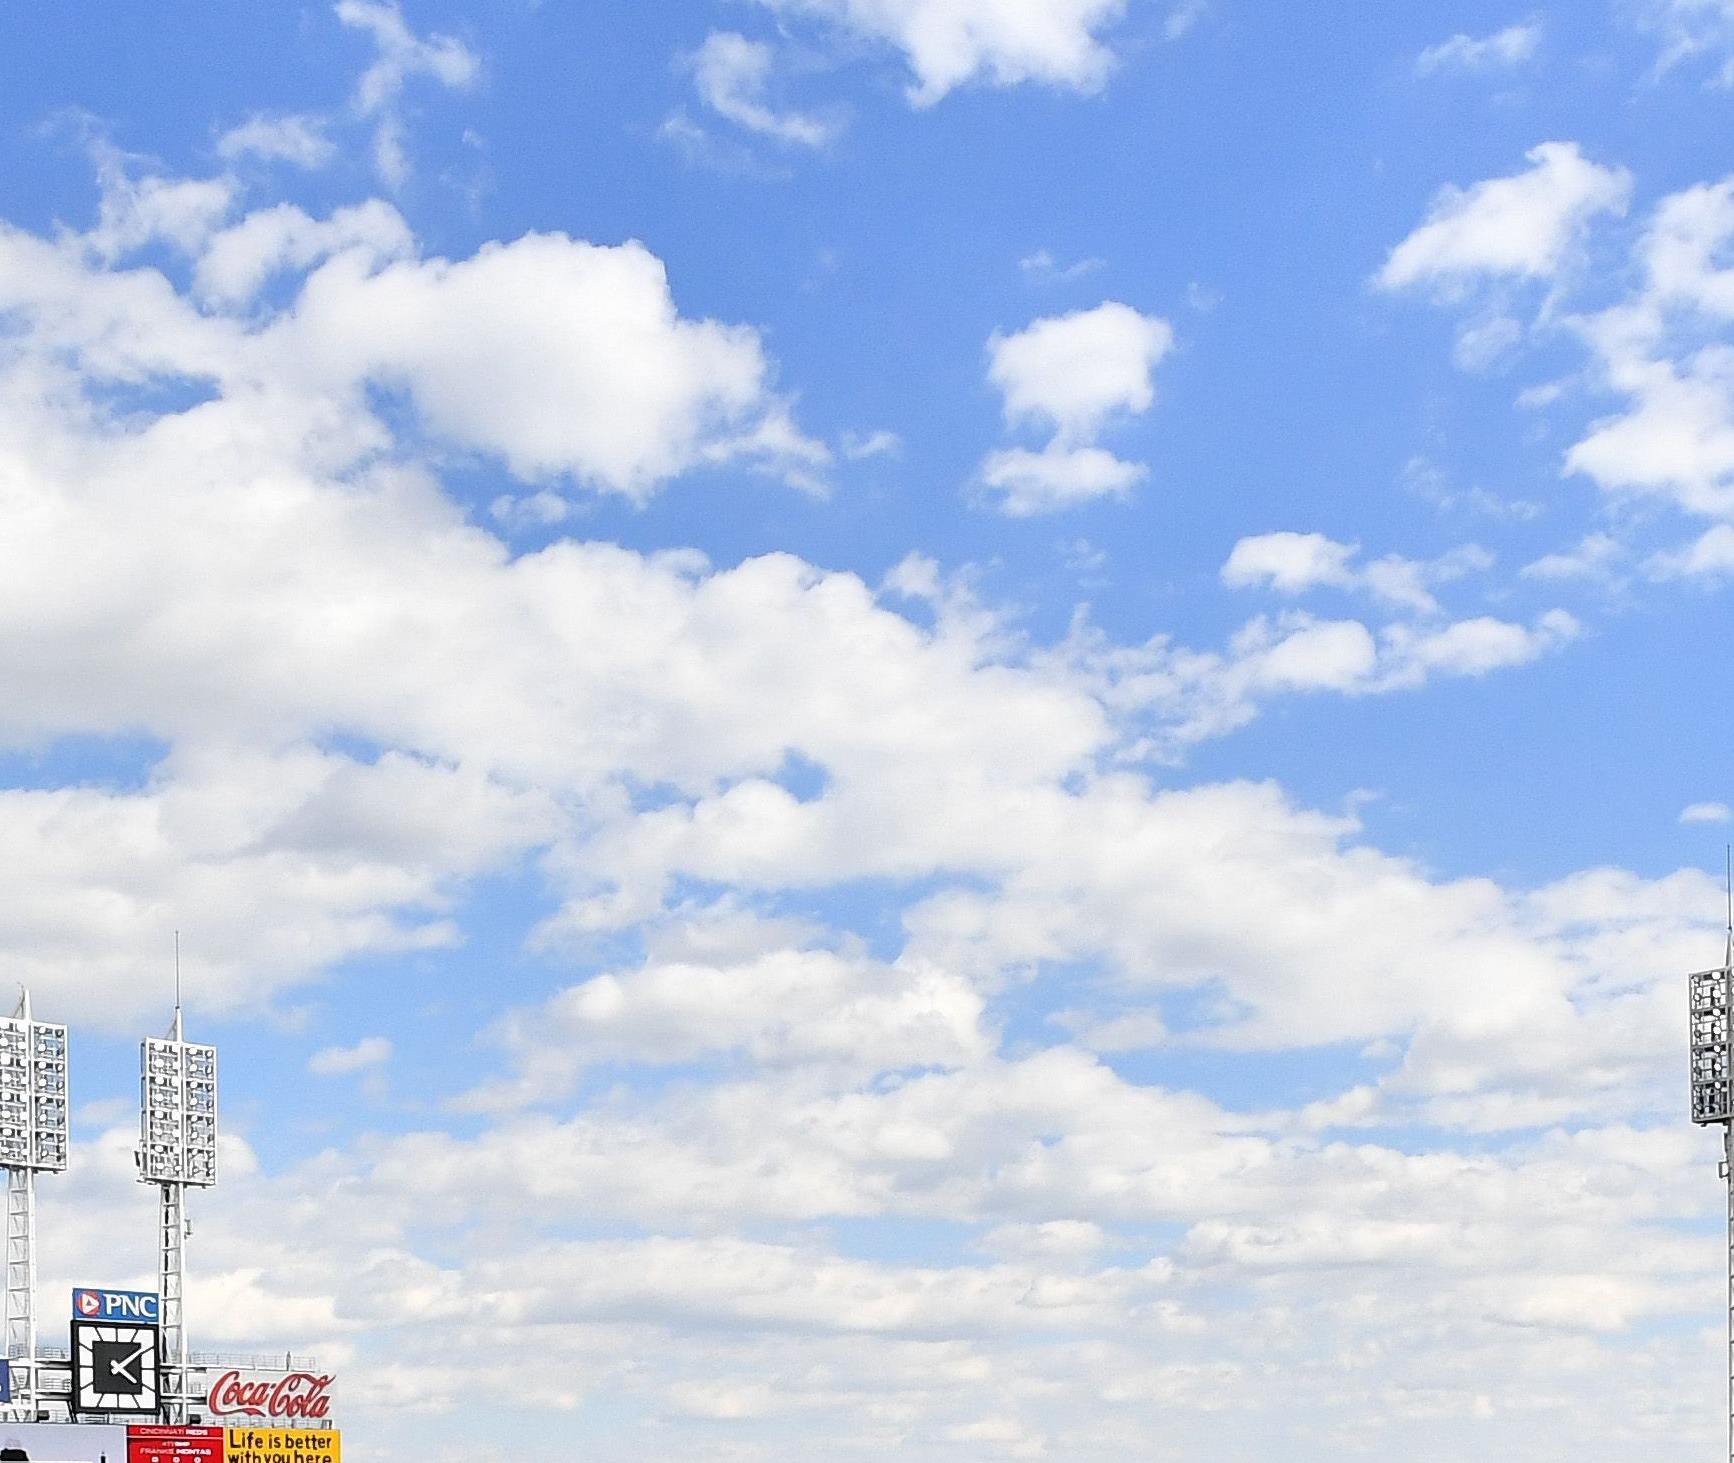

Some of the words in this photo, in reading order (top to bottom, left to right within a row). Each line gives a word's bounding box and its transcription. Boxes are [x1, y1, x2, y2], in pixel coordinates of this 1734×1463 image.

[104, 1293, 158, 1319] PNC
[186, 1428, 208, 1436] REDS
[229, 1429, 262, 1449] Life
[268, 1433, 280, 1449] is
[285, 1435, 331, 1450] better
